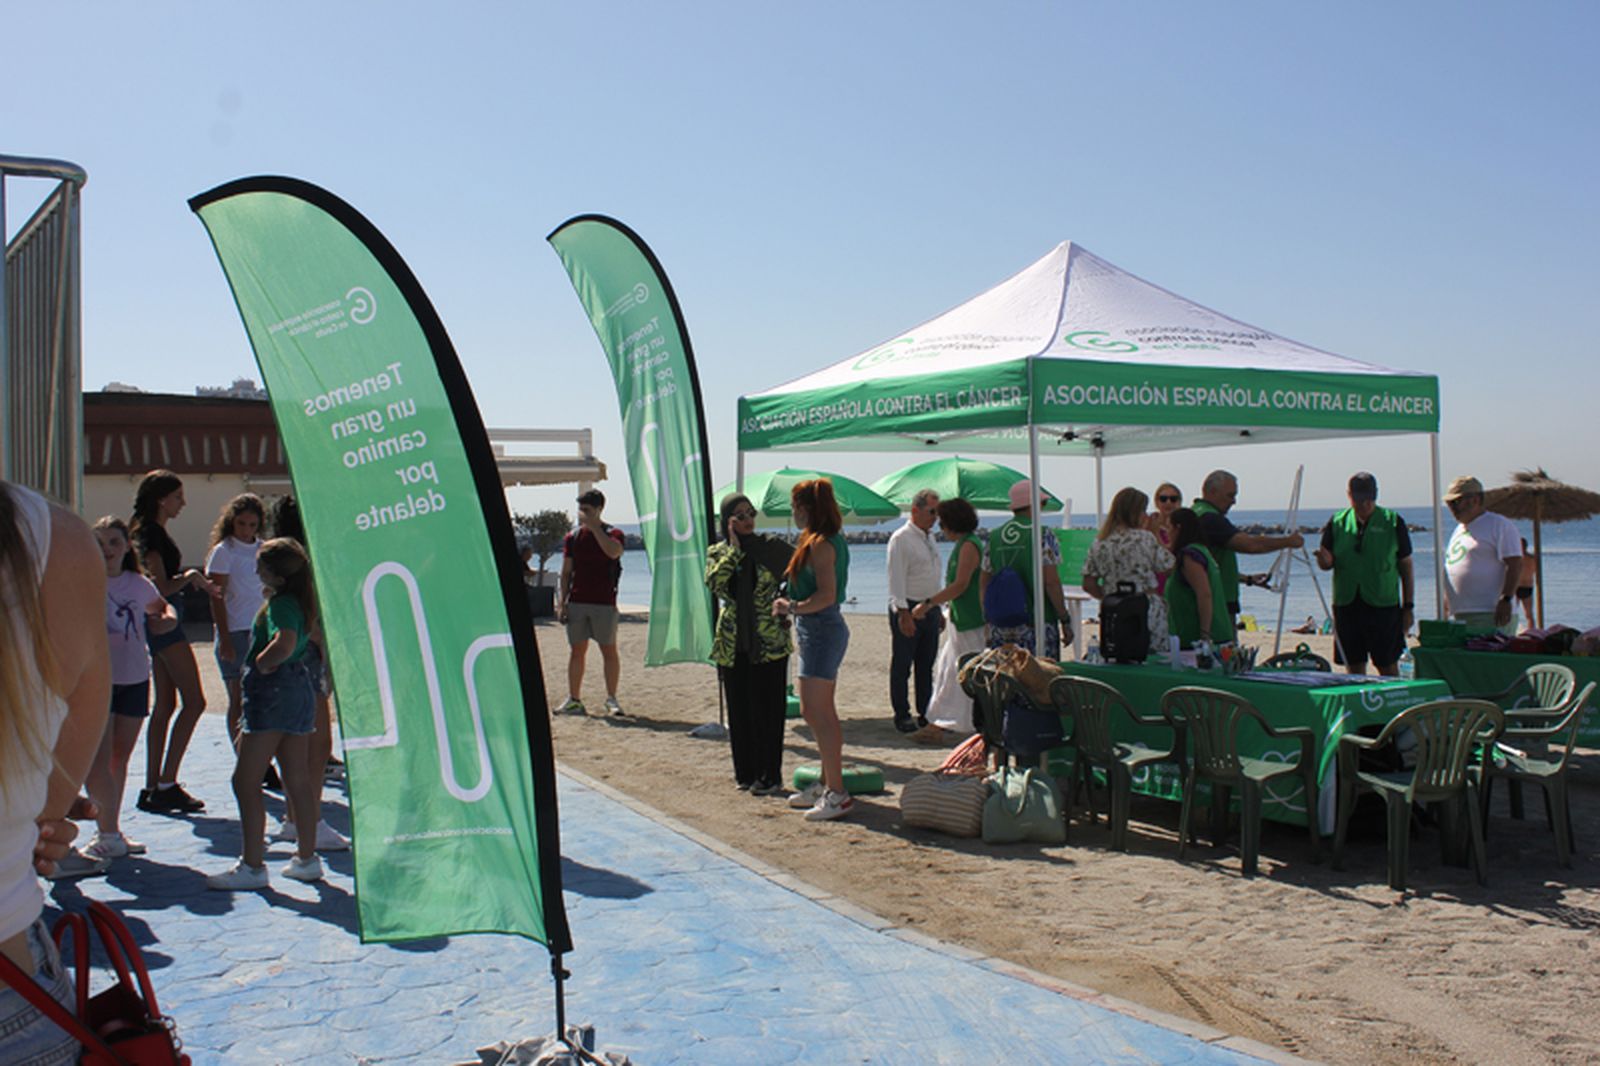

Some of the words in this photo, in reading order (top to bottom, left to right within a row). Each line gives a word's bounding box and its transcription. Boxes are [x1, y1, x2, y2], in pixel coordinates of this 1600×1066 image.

[809, 398, 874, 425] ESPAÑOLA
[875, 394, 934, 417] CONTRA
[936, 392, 954, 412] EL
[956, 384, 1022, 411] CÁNCER
[1043, 381, 1168, 406] ASOCIACIÓN
[1172, 384, 1270, 409] ESPAÑOLA
[1272, 389, 1343, 412] CONTRA
[1346, 393, 1367, 413] EL
[1368, 391, 1434, 415] CÁNCER
